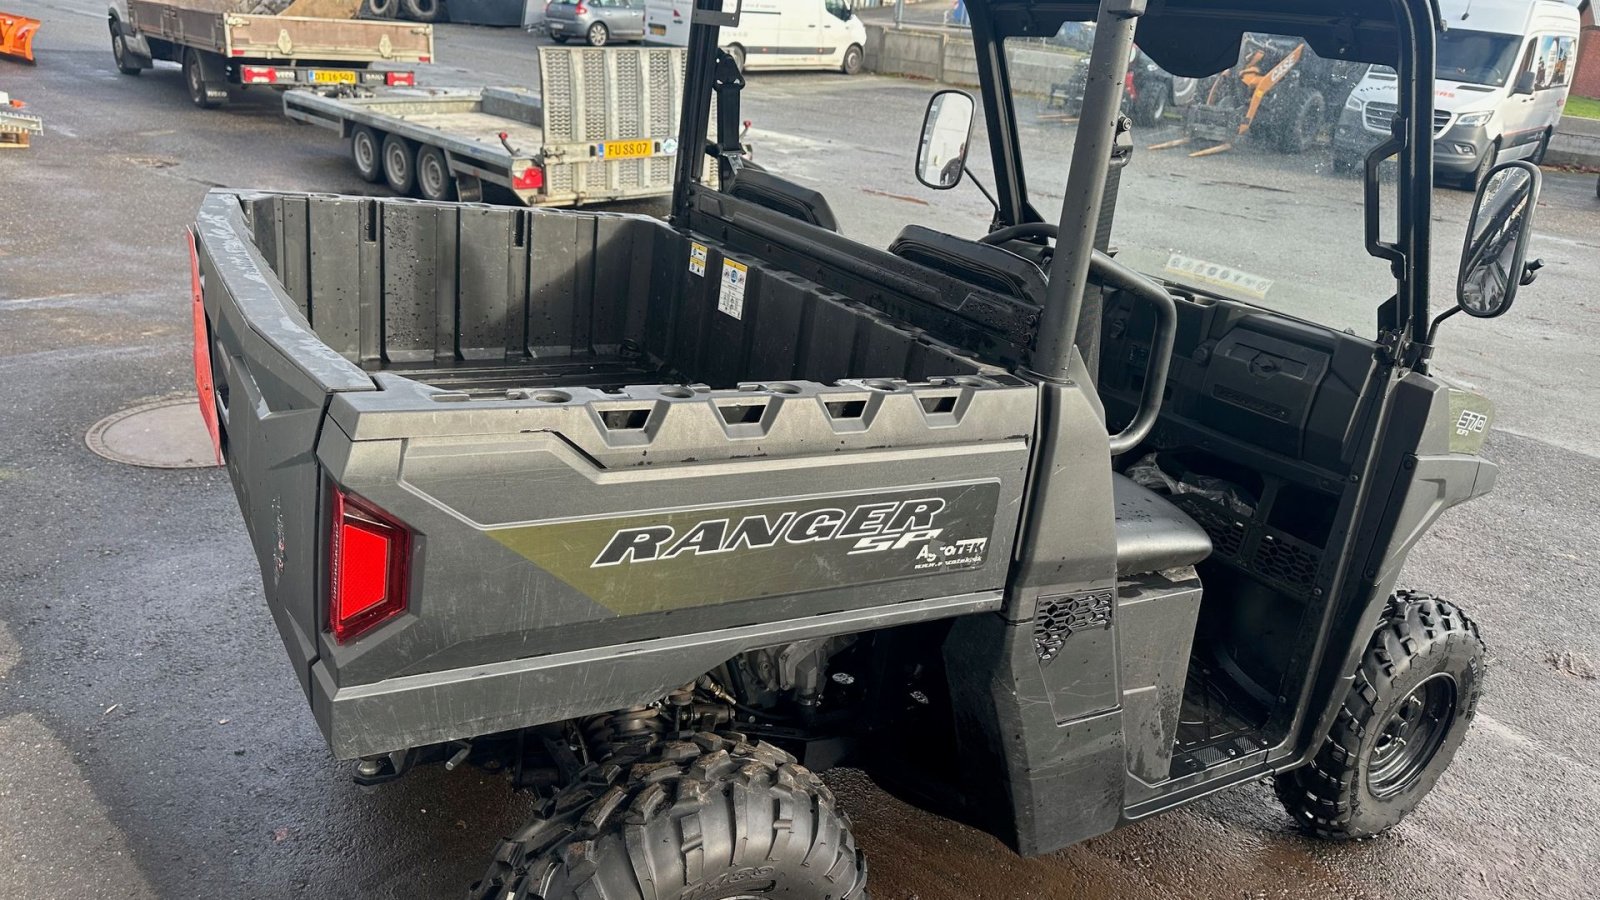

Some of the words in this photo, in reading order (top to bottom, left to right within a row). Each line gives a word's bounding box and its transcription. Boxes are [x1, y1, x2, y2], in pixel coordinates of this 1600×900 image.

[1456, 410, 1487, 433] 570
[590, 497, 946, 568] RANGER
[846, 528, 944, 555] SP
